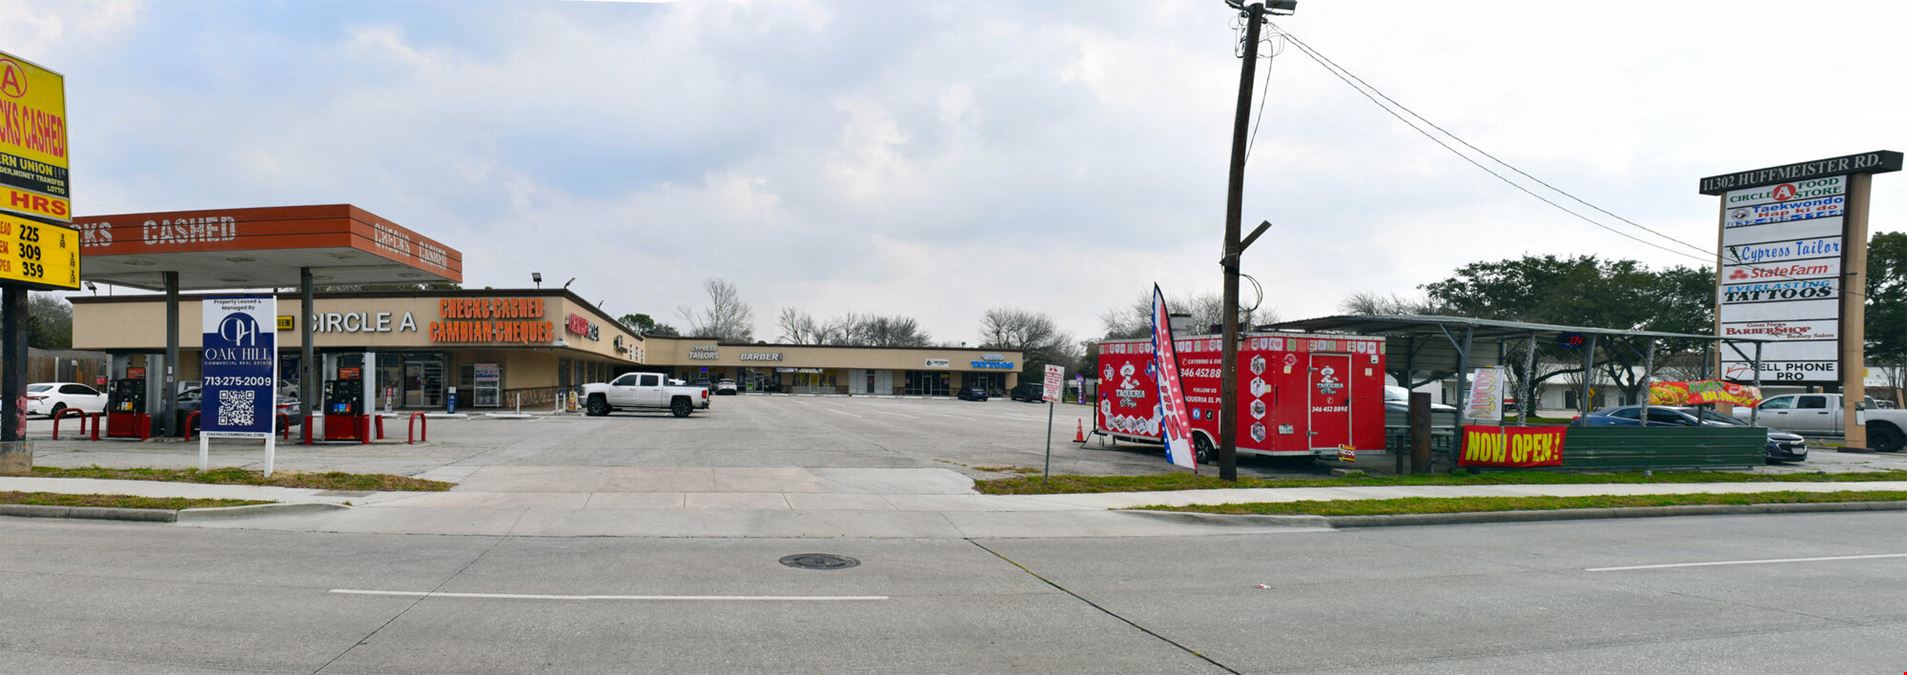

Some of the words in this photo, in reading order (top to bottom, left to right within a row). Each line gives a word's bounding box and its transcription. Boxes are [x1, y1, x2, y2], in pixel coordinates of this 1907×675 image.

[23, 105, 64, 158] CASHED
[0, 153, 17, 168] RN
[20, 158, 53, 177] UNION
[1703, 177, 1735, 191] 11302
[1738, 157, 1849, 186] HUFFMEISTER
[1854, 152, 1883, 169] RD.
[47, 185, 65, 195] LOTTO
[1798, 177, 1839, 190] FOOD
[1730, 190, 1774, 203] CIRCLE
[1776, 185, 1792, 199] A
[1795, 185, 1842, 199] STORE
[11, 191, 66, 215] HRS
[1751, 197, 1844, 213] Taekwondo
[1759, 210, 1790, 219] Hap
[20, 225, 39, 242] 225
[143, 216, 236, 245] CASHED
[19, 242, 41, 261] 309
[374, 223, 410, 256] CHECKS
[420, 241, 447, 269] CASHED
[1742, 247, 1790, 263] Cypress
[1796, 240, 1839, 257] Tailor
[23, 262, 43, 278] 359
[1725, 287, 1832, 301] TATTOOS
[1727, 280, 1830, 292] EVERLASTING
[439, 297, 490, 319] CHECKS
[493, 297, 545, 319] CASHED
[400, 311, 417, 332] A
[429, 320, 493, 343] CAMBIAN
[496, 320, 554, 345] CHEQUES
[205, 348, 236, 360] OAK
[243, 348, 270, 360] HILL
[689, 352, 719, 360] TAILORS
[740, 352, 778, 361] BARBER
[1180, 367, 1194, 377] 346
[1786, 363, 1834, 371] PHONE
[204, 376, 272, 387] 713-275-2009
[1777, 372, 1804, 380] PRO
[1465, 431, 1508, 463] NOW
